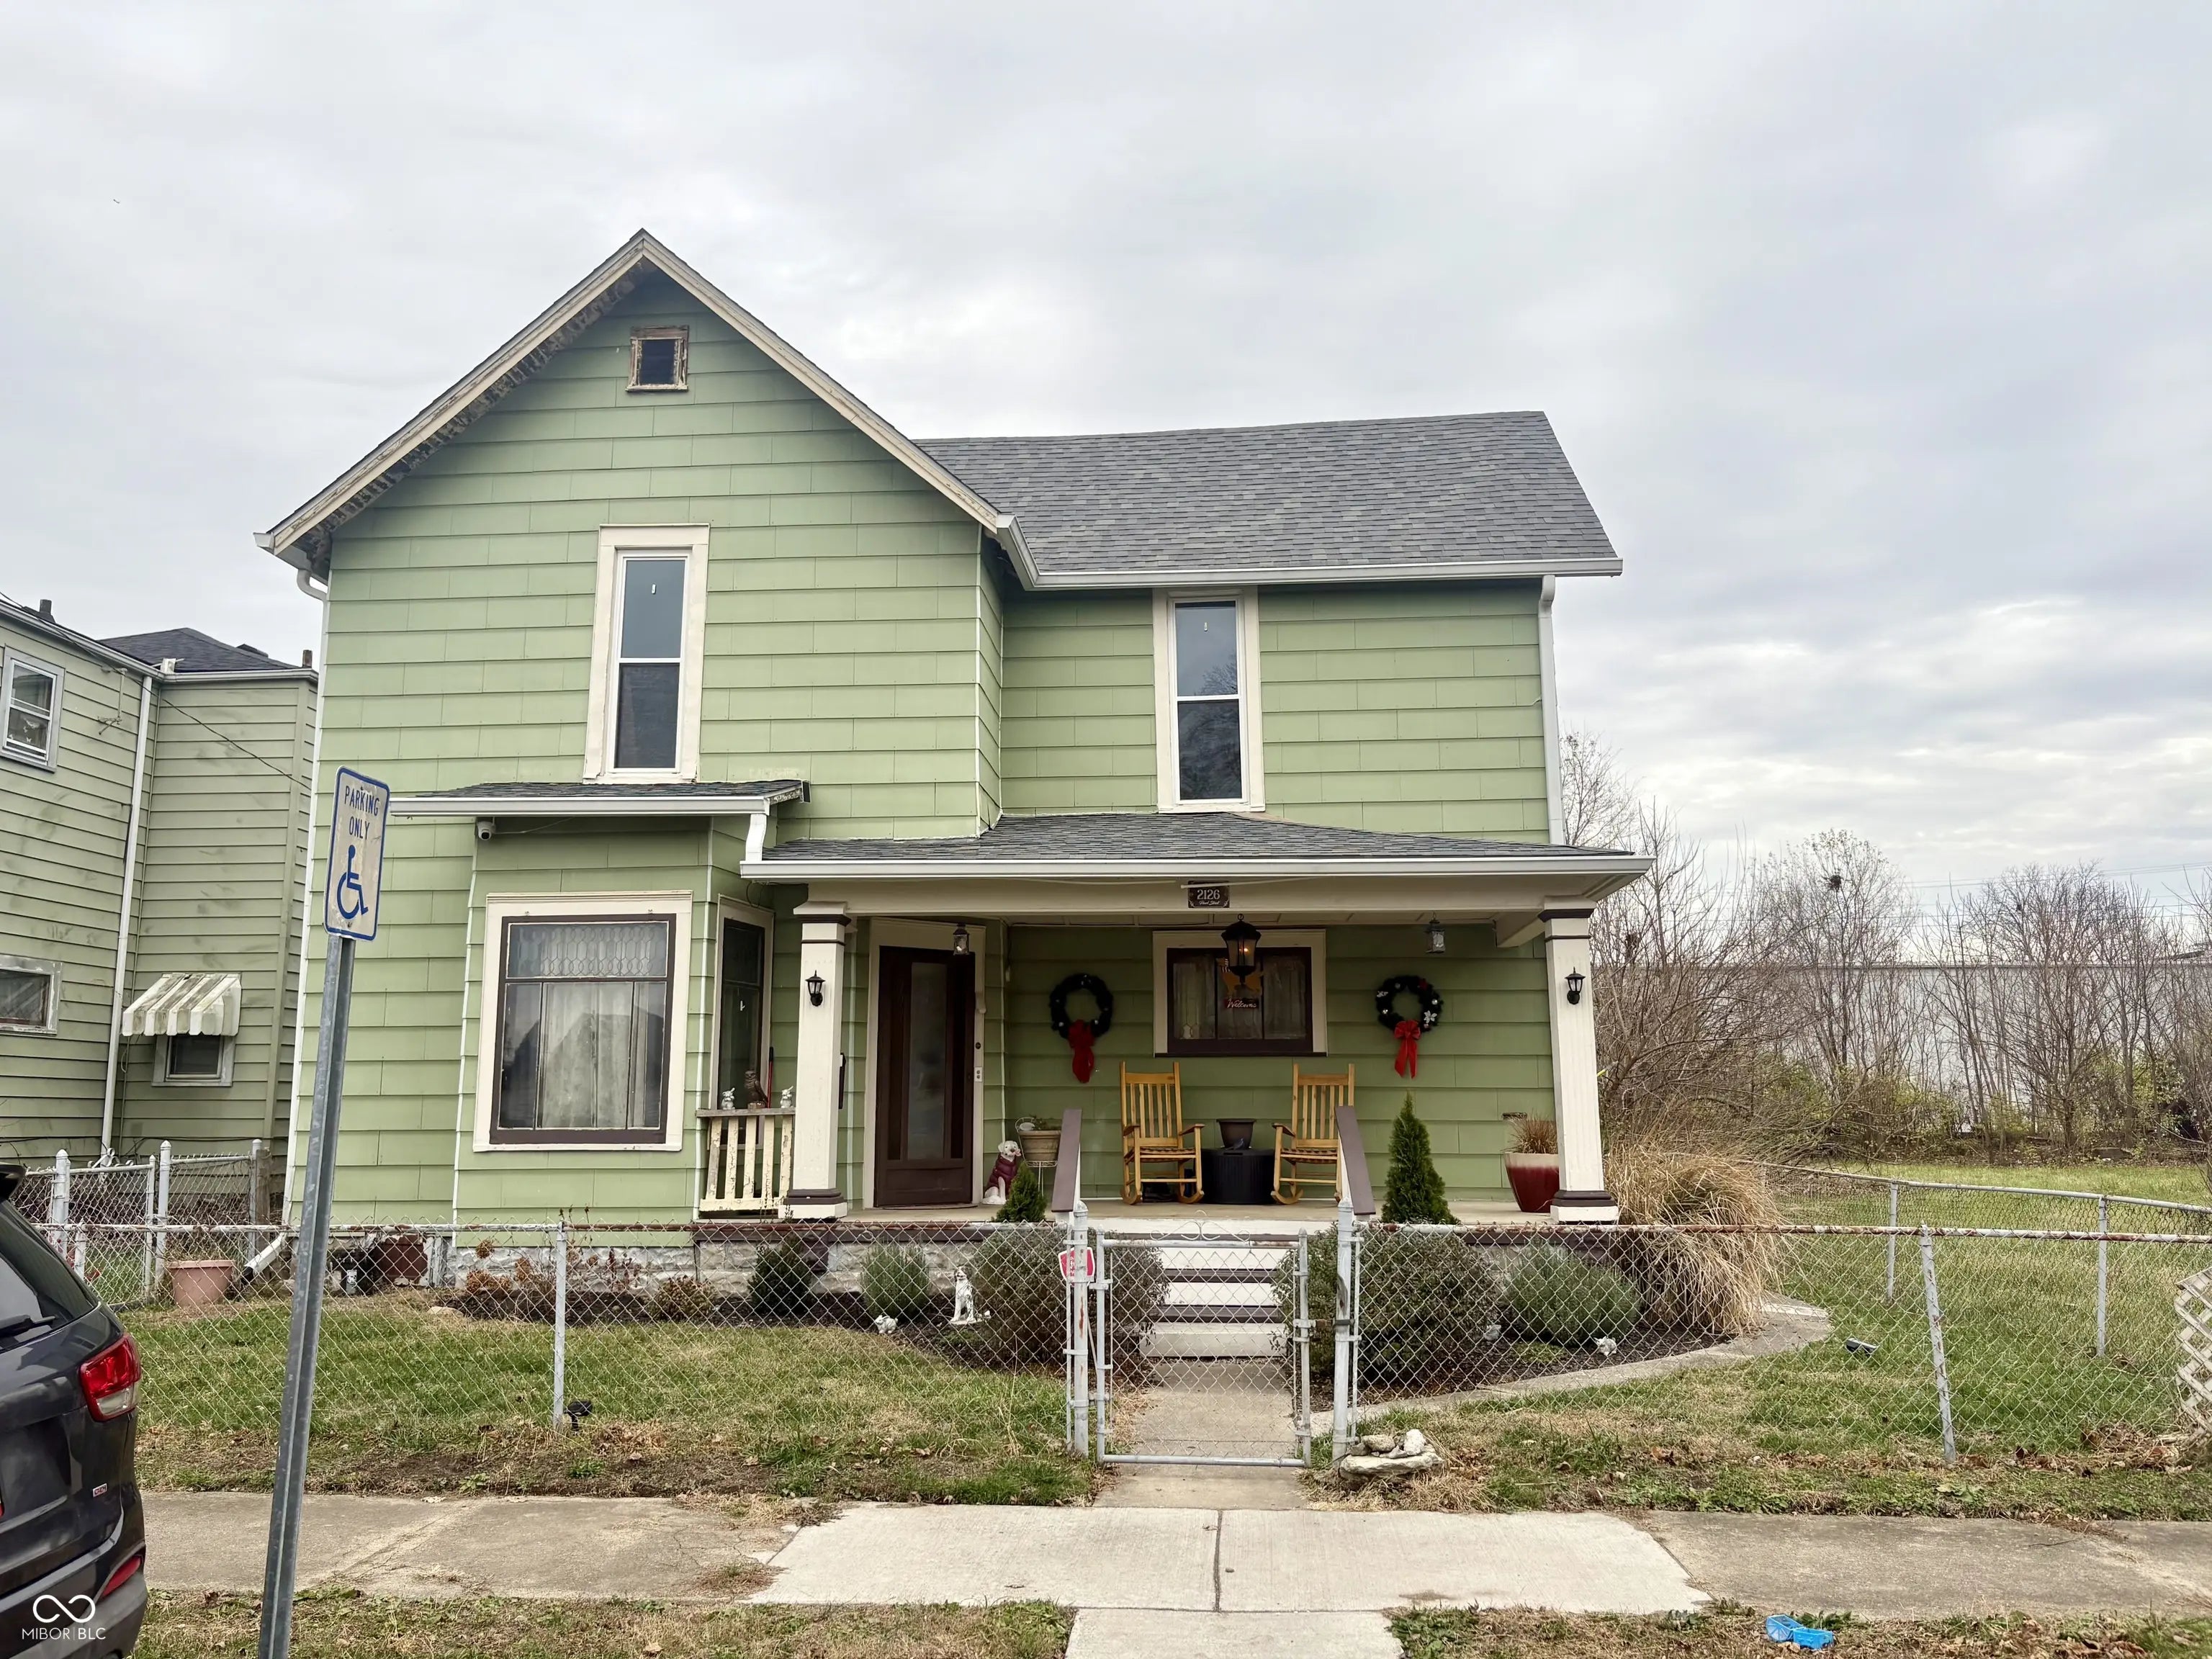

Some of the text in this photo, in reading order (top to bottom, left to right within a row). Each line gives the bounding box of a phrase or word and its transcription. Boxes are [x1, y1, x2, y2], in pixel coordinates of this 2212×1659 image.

[344, 785, 380, 817] PARKING
[349, 816, 371, 840] ONLY
[1197, 889, 1220, 900] 2126
[1227, 997, 1257, 1008] Welcome
